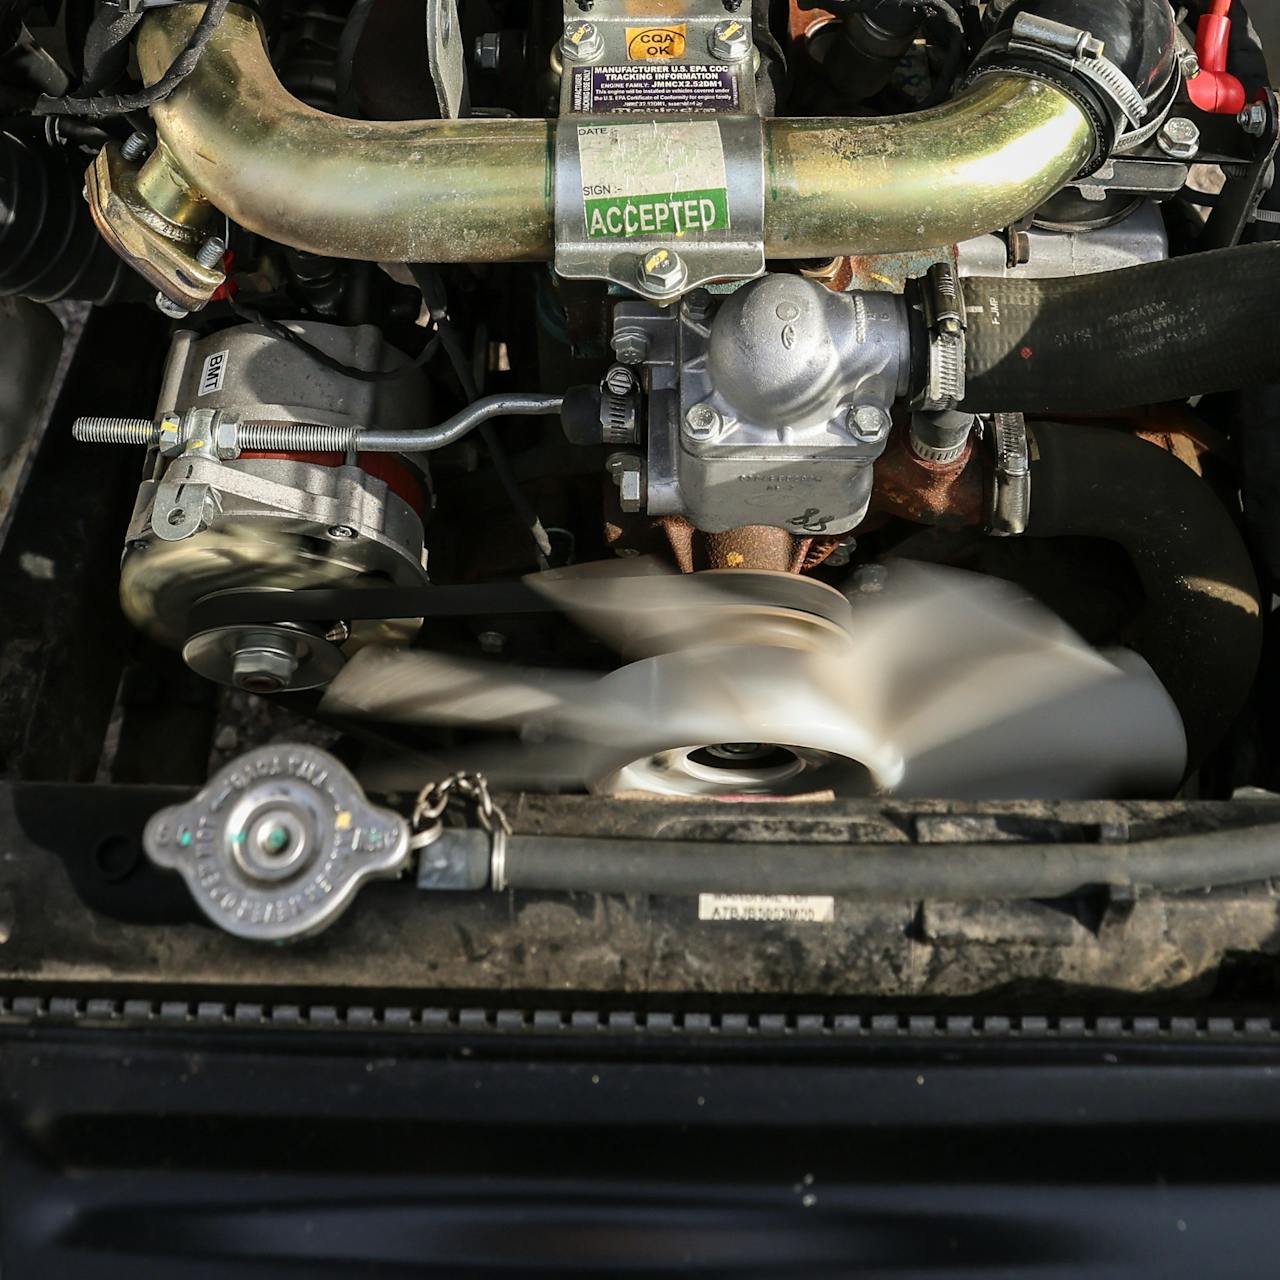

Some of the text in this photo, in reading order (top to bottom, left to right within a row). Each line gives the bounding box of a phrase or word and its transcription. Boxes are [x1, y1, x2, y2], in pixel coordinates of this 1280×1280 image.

[640, 33, 675, 44] CQA
[646, 46, 670, 56] OK
[594, 65, 729, 74] MANUFACTURER U.S. EPA COC
[605, 72, 719, 81] TRACKING INFORMATION
[578, 127, 608, 136] DATE
[583, 185, 611, 197] SIGN
[589, 198, 716, 235] ACCEPTED
[204, 353, 224, 390] BMT
